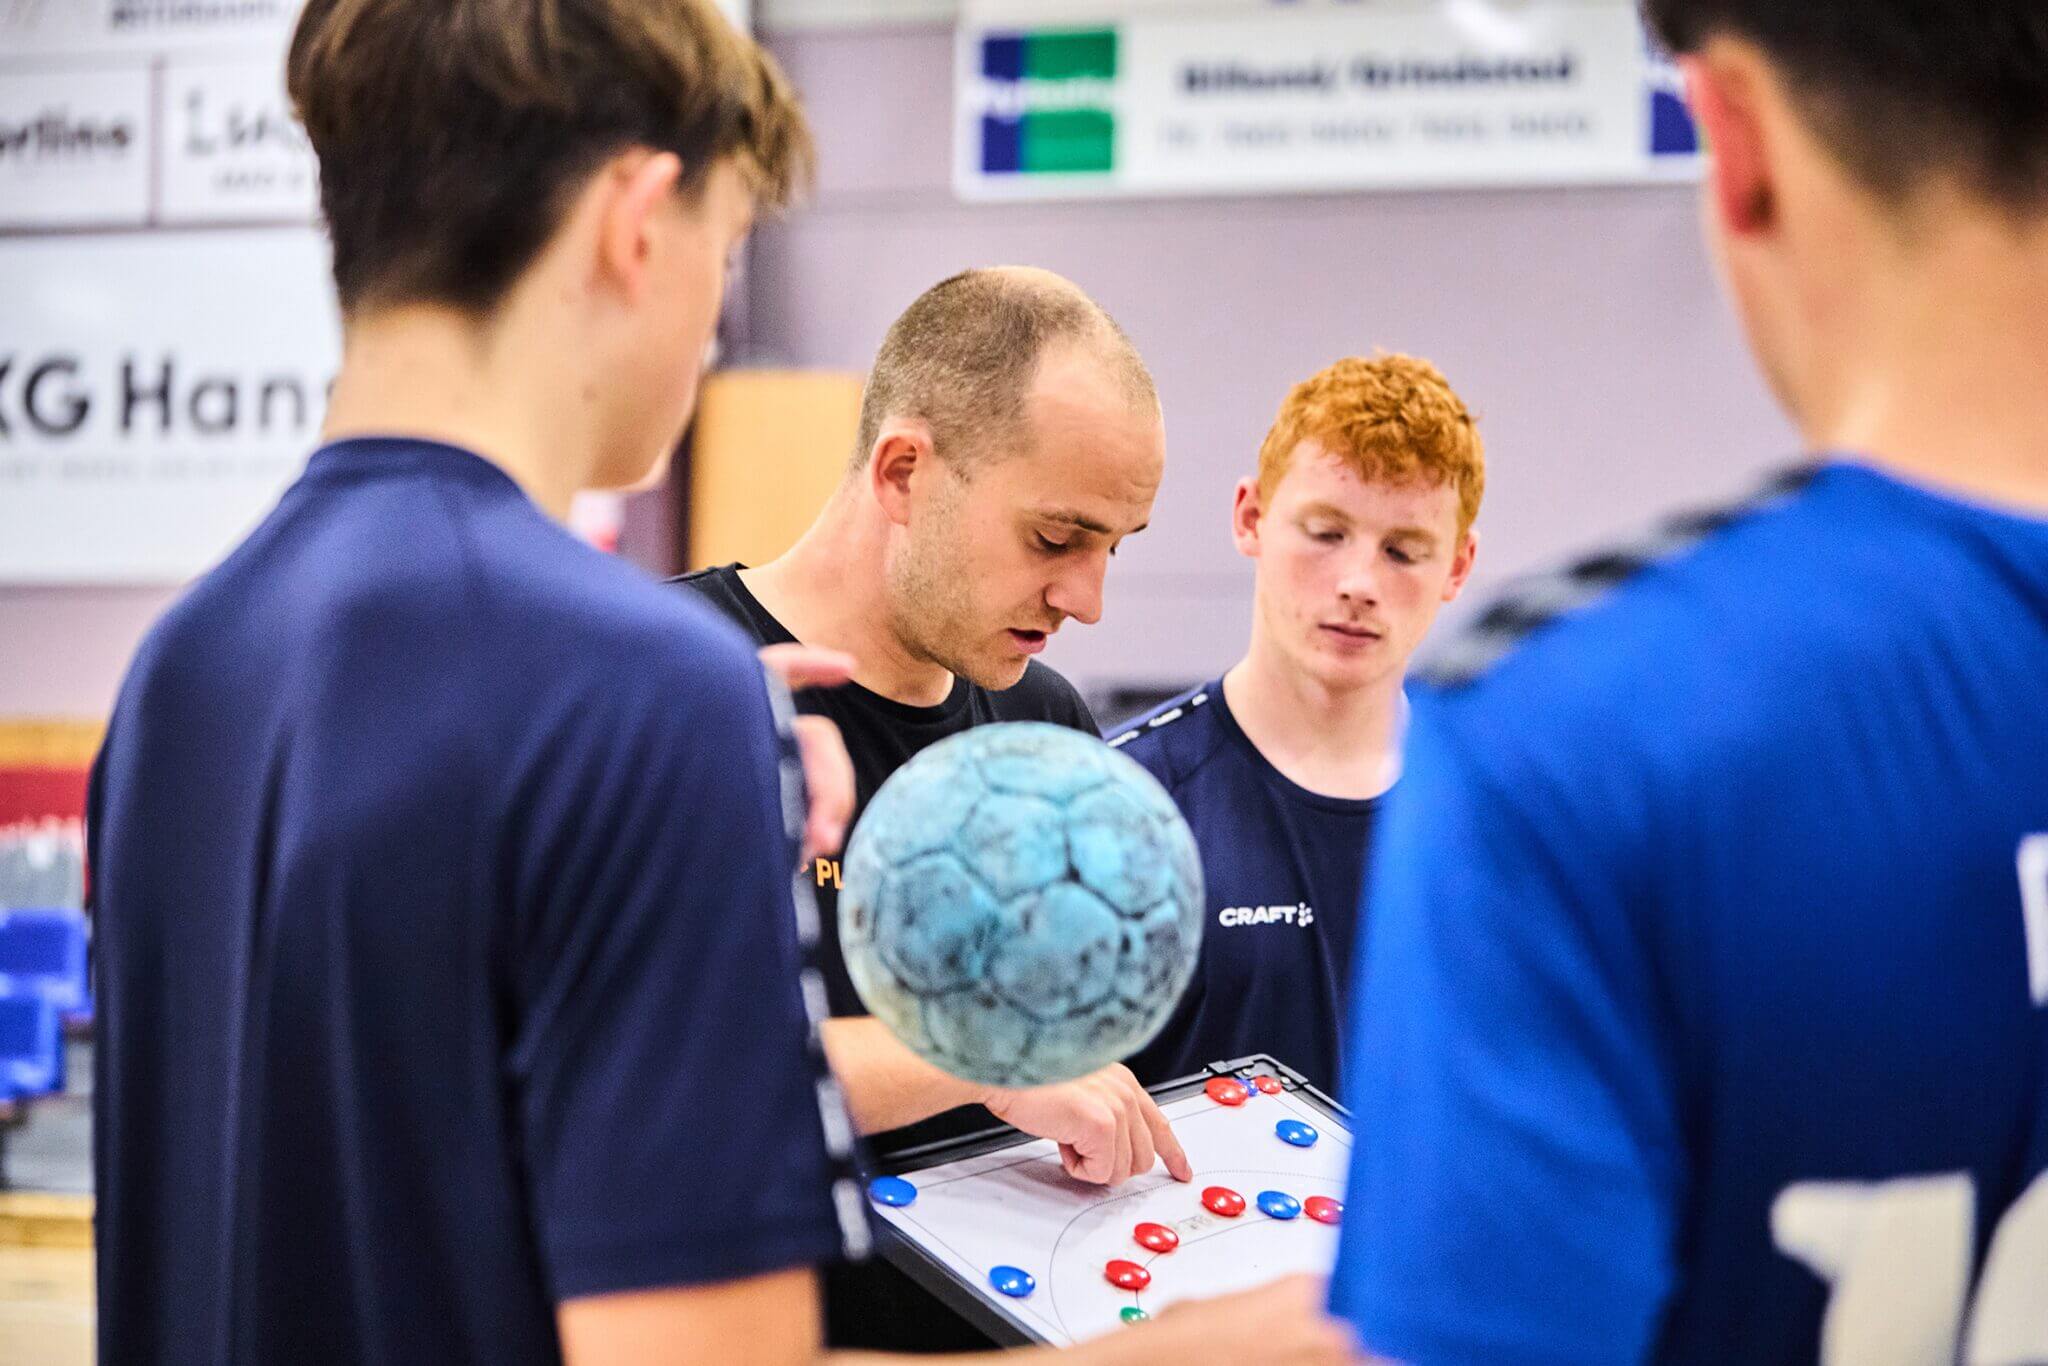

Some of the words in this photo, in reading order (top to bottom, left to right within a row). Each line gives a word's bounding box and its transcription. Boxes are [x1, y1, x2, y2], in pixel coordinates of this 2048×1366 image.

[0, 354, 92, 439] G
[116, 354, 334, 438] Han
[1218, 905, 1298, 927] CRAFT
[1769, 1166, 2048, 1366] 1
